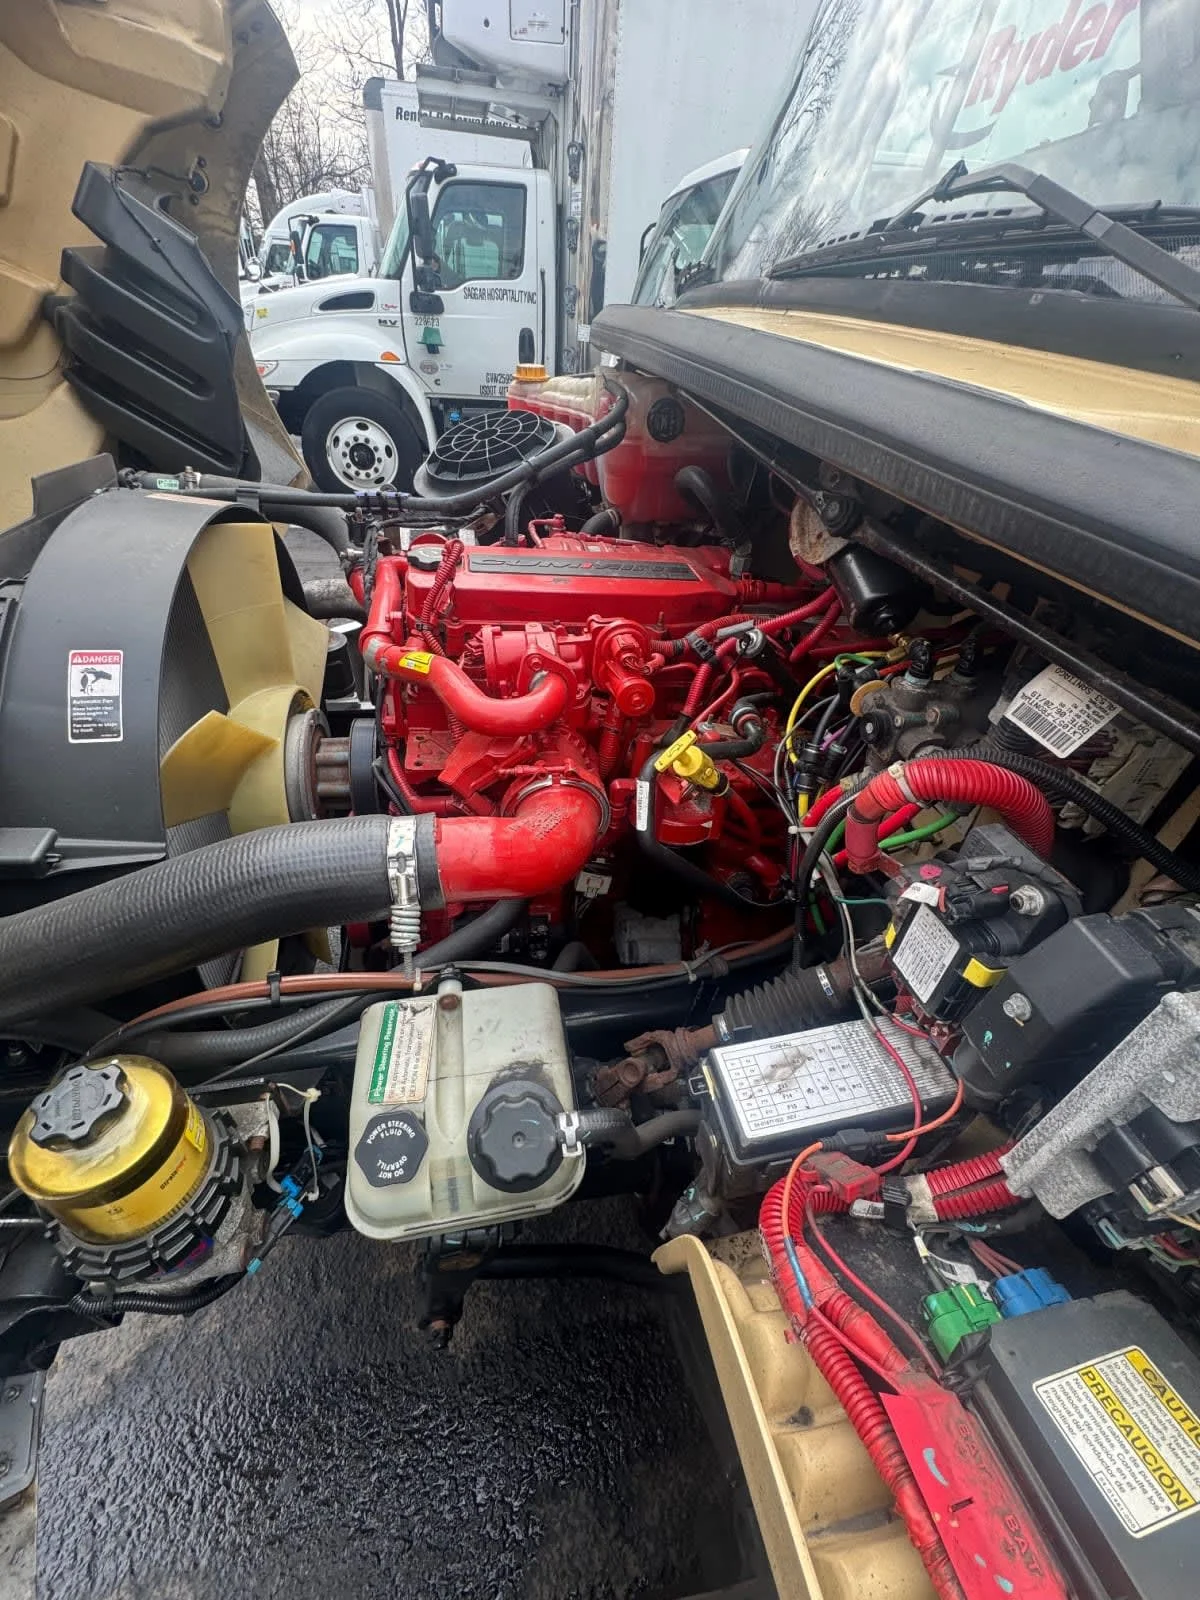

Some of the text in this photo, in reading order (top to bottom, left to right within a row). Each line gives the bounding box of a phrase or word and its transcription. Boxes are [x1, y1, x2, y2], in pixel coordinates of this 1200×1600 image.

[964, 0, 1139, 113] Ryder
[82, 655, 120, 664] DANGER
[373, 1072, 384, 1096] Power
[366, 1120, 416, 1145] POWER STEERING
[380, 1128, 403, 1139] FLUID
[377, 1155, 408, 1171] OVERFILL
[378, 1168, 404, 1179] DO NOT
[1049, 1386, 1074, 1417] manual
[1081, 1432, 1117, 1478] conductor
[1079, 1369, 1189, 1506] PRECAUCIÓN
[1114, 1452, 1151, 1495] Consulte
[1164, 1442, 1196, 1475] Manual
[1137, 1469, 1167, 1503] puente
[1004, 1513, 1044, 1578] BAT
